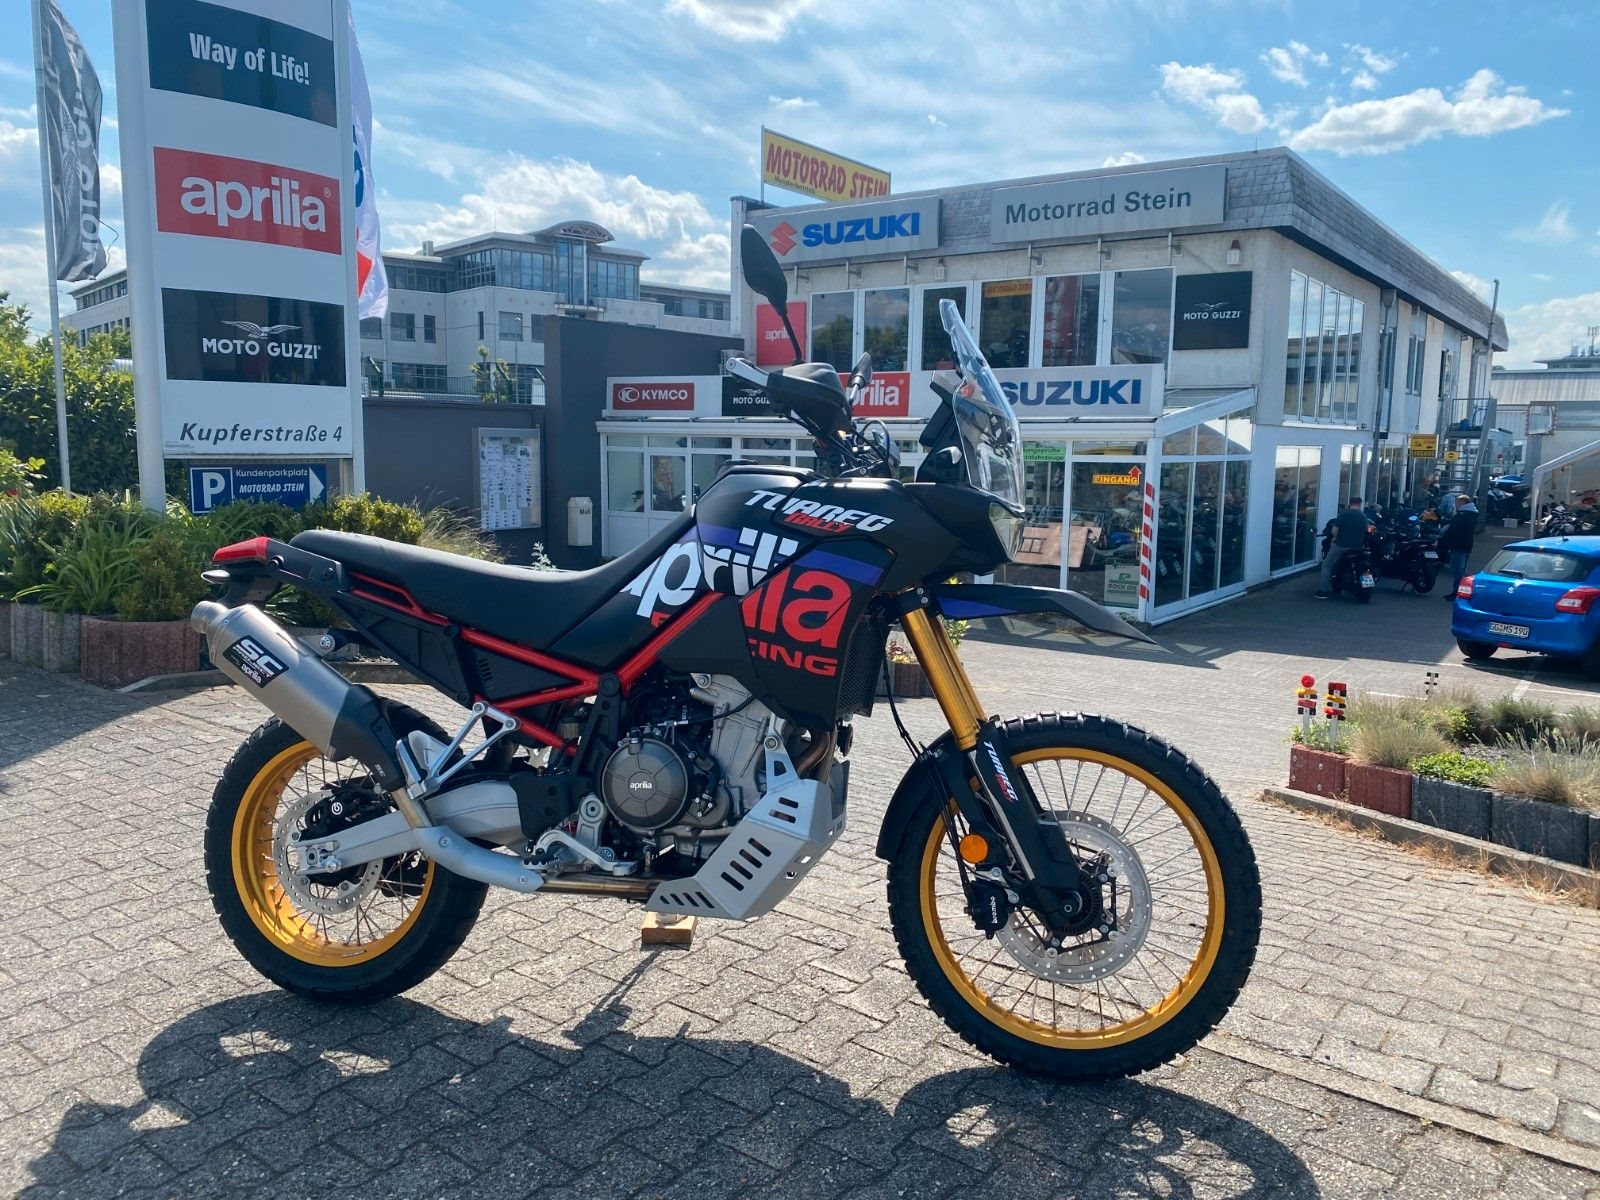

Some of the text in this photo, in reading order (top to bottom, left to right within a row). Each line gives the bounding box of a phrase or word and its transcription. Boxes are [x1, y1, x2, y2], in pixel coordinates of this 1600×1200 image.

[189, 32, 310, 85] Way of Life!
[766, 142, 887, 198] MOTORRAD STEIN
[180, 175, 326, 232] aprilia
[1005, 187, 1192, 225] Motorrad Stein
[802, 211, 920, 248] SUZUKI
[1184, 311, 1240, 321] MOTO GUZZI
[203, 338, 319, 360] MOTO GUZZI
[641, 389, 689, 401] KYMCO
[733, 397, 752, 405] MOTO
[180, 422, 343, 445] Kupferstraße 4
[235, 468, 309, 479] Kundenparkplatz
[1094, 476, 1138, 485] EINGANG
[202, 471, 226, 509] P
[239, 483, 305, 494] MOTORRAD STEIN
[234, 638, 284, 678] SC
[630, 781, 653, 791] aprilia
[990, 895, 998, 925] brembo
